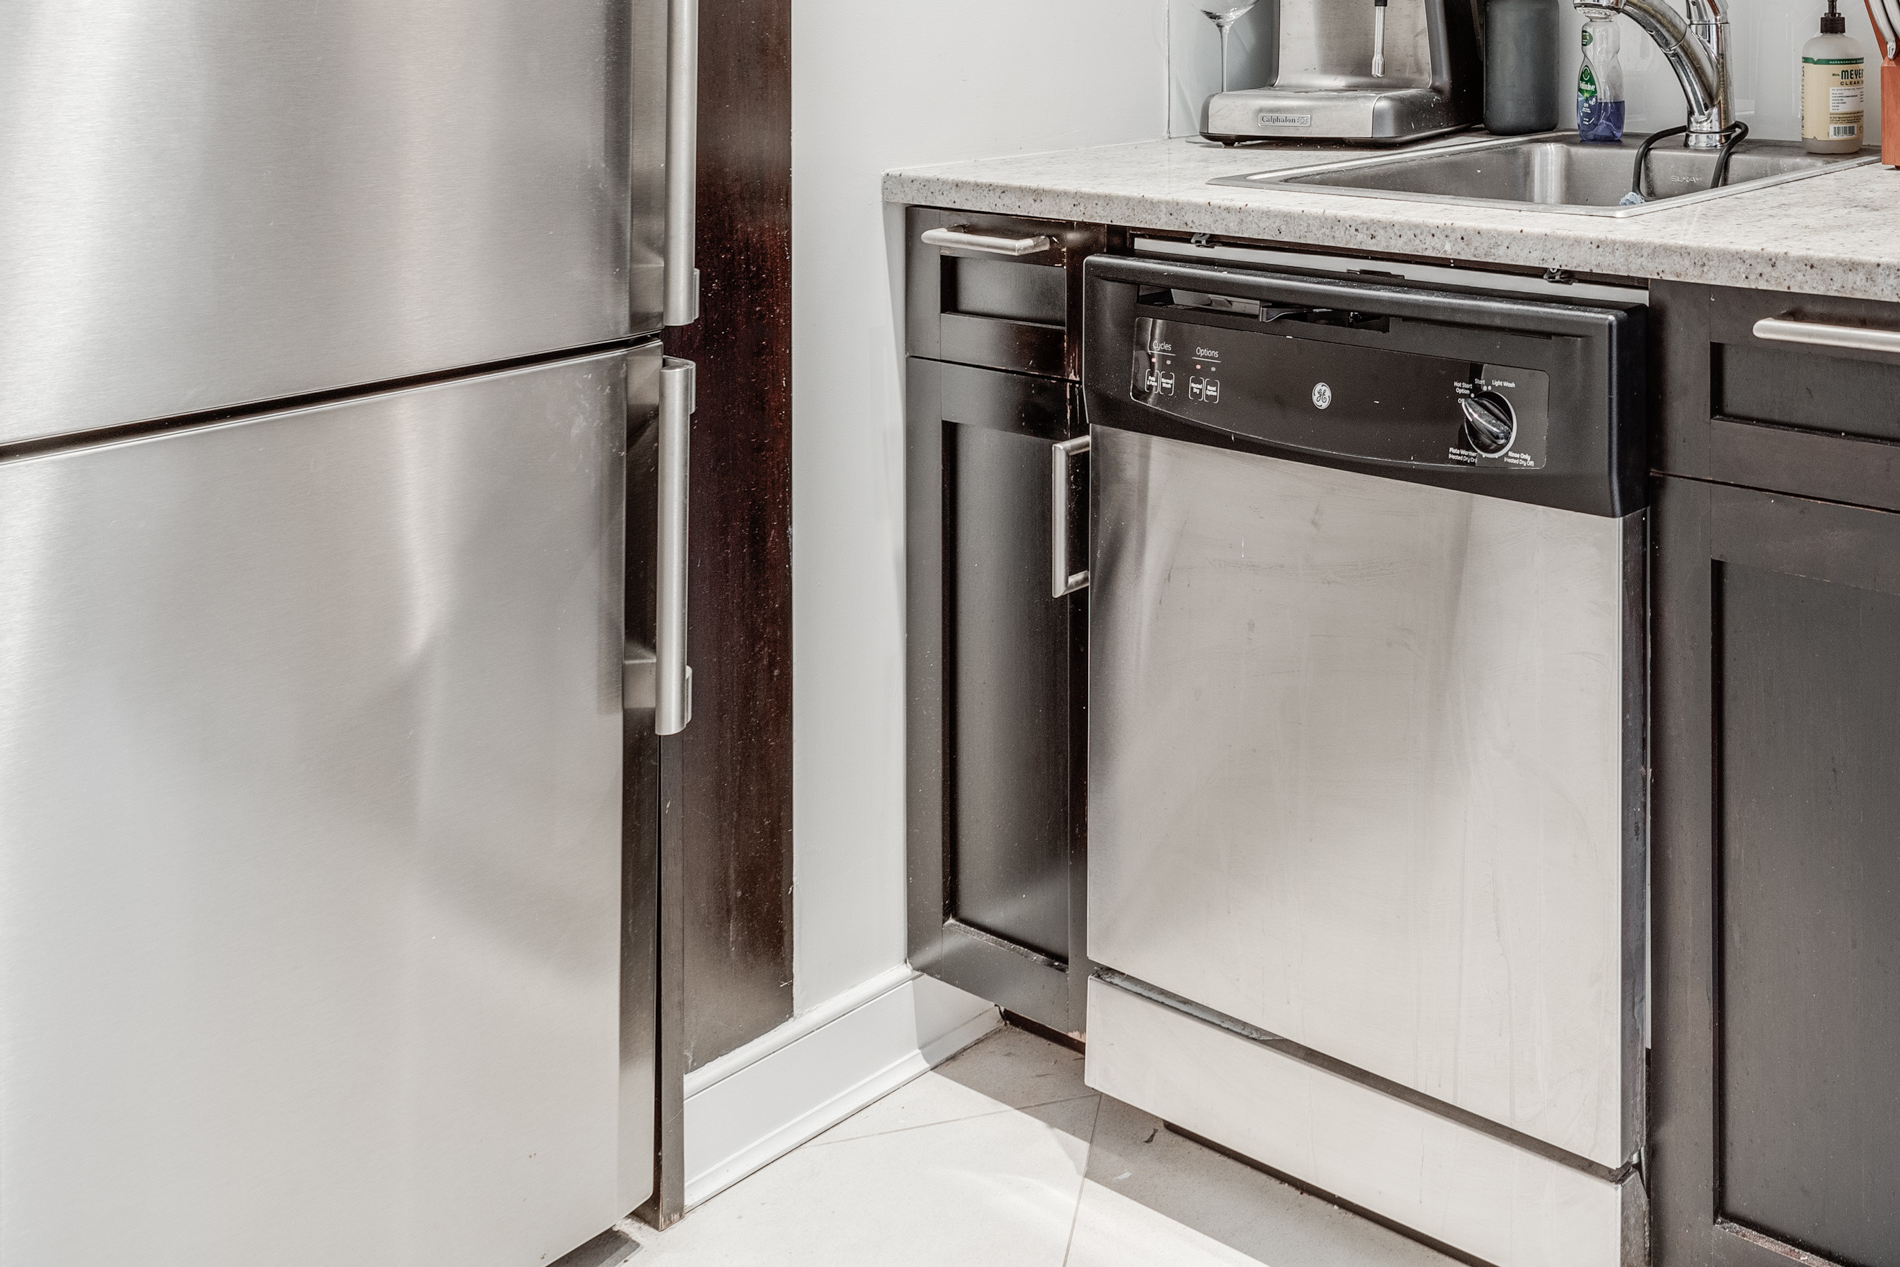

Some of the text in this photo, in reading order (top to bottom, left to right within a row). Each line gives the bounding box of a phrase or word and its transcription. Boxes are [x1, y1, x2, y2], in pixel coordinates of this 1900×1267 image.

[1261, 115, 1296, 124] Calphalon
[1153, 341, 1172, 351] Cycles
[1196, 347, 1219, 357] Options
